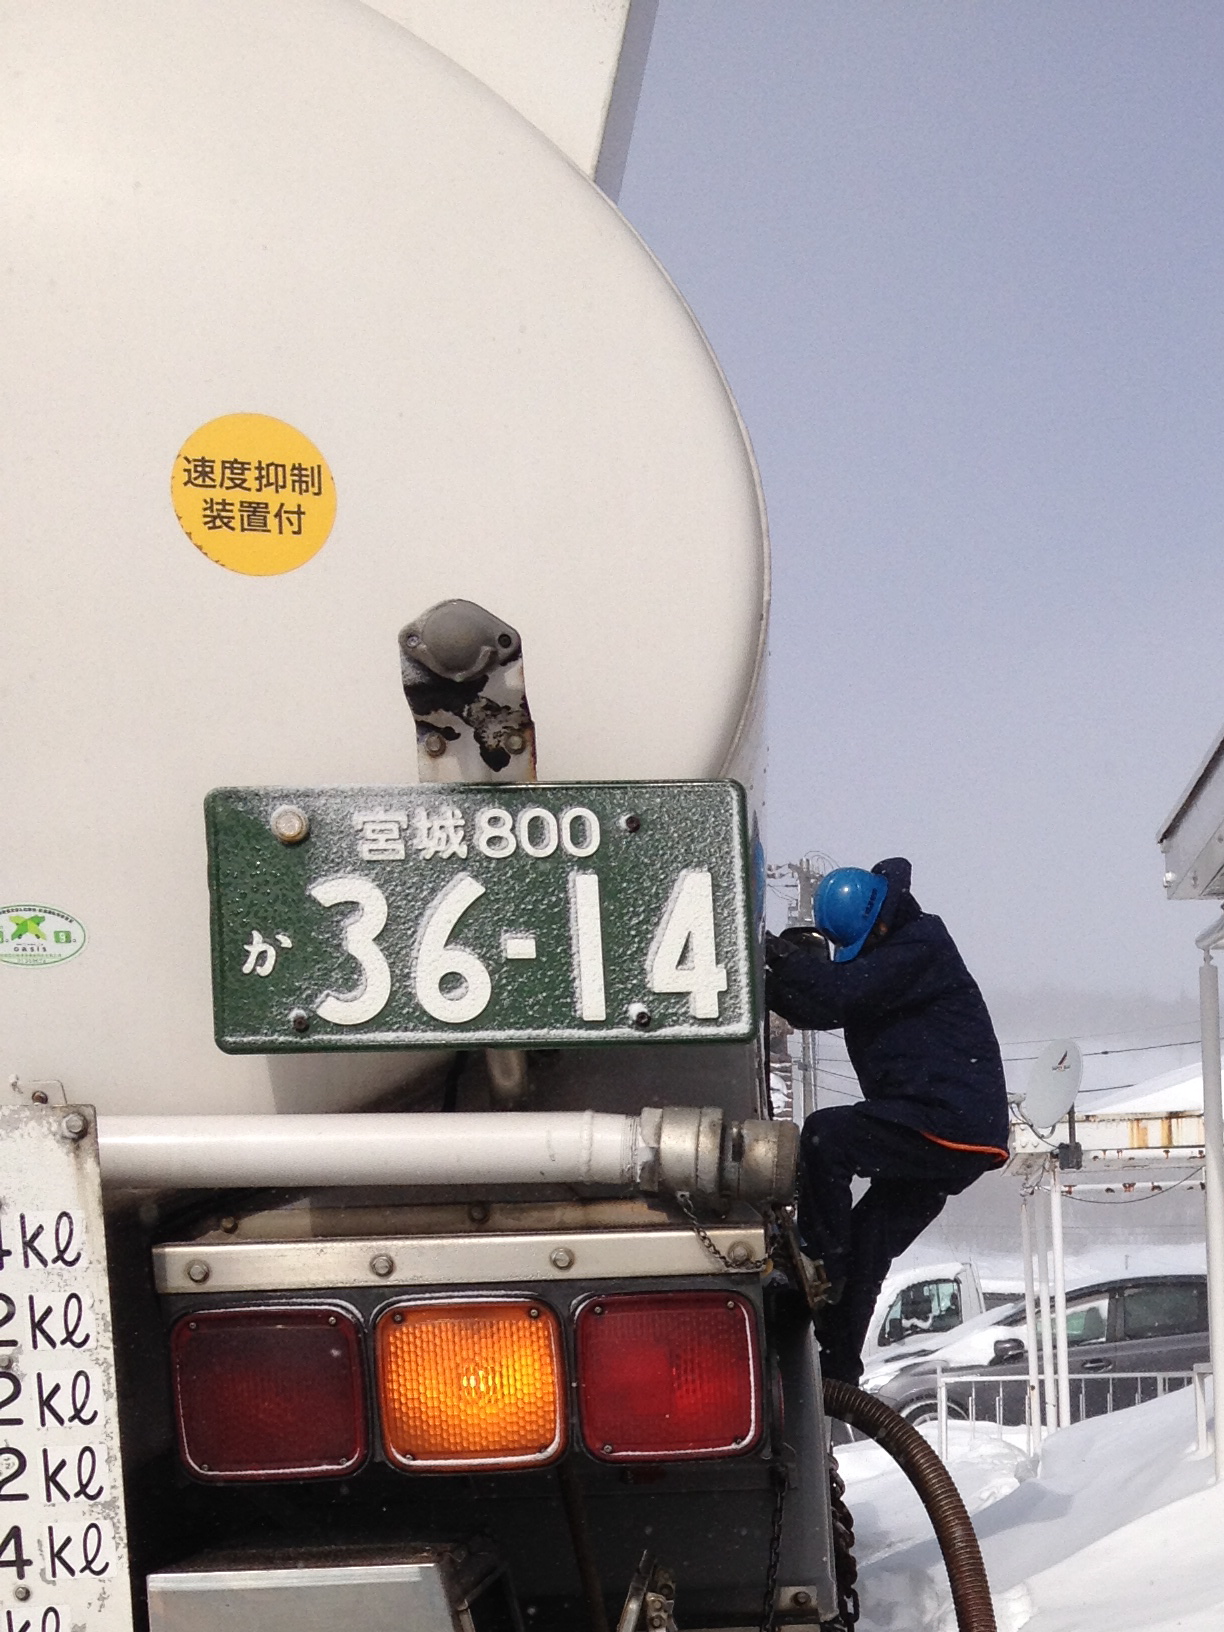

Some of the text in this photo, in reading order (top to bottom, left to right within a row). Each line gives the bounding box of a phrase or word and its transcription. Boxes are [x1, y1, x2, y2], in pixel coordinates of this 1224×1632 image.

[182, 456, 323, 497] 速度抑制
[202, 498, 306, 536] 装置付
[242, 871, 729, 1026] か 36-14
